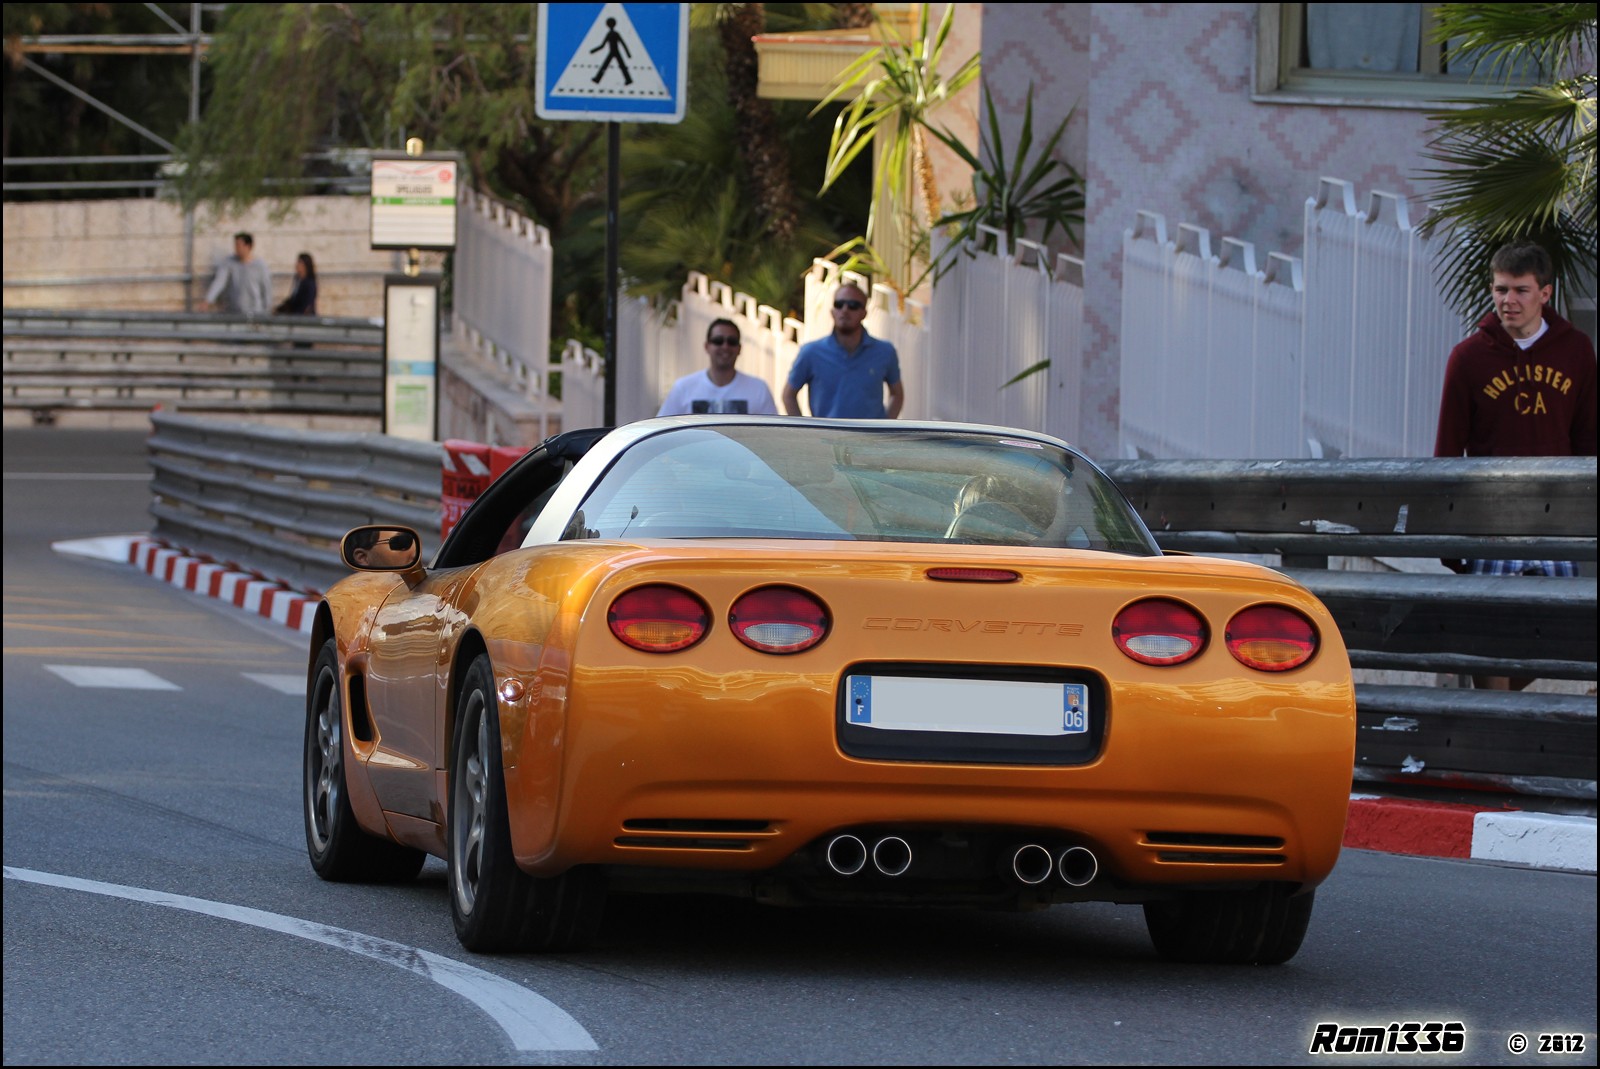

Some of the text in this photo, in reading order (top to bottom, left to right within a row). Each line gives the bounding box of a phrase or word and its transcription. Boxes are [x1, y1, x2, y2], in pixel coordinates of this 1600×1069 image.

[1483, 364, 1572, 400] HOLLISTER
[1514, 391, 1547, 415] CA
[862, 617, 1085, 637] CORVETTE
[857, 705, 865, 716] F
[1064, 710, 1083, 728] 06
